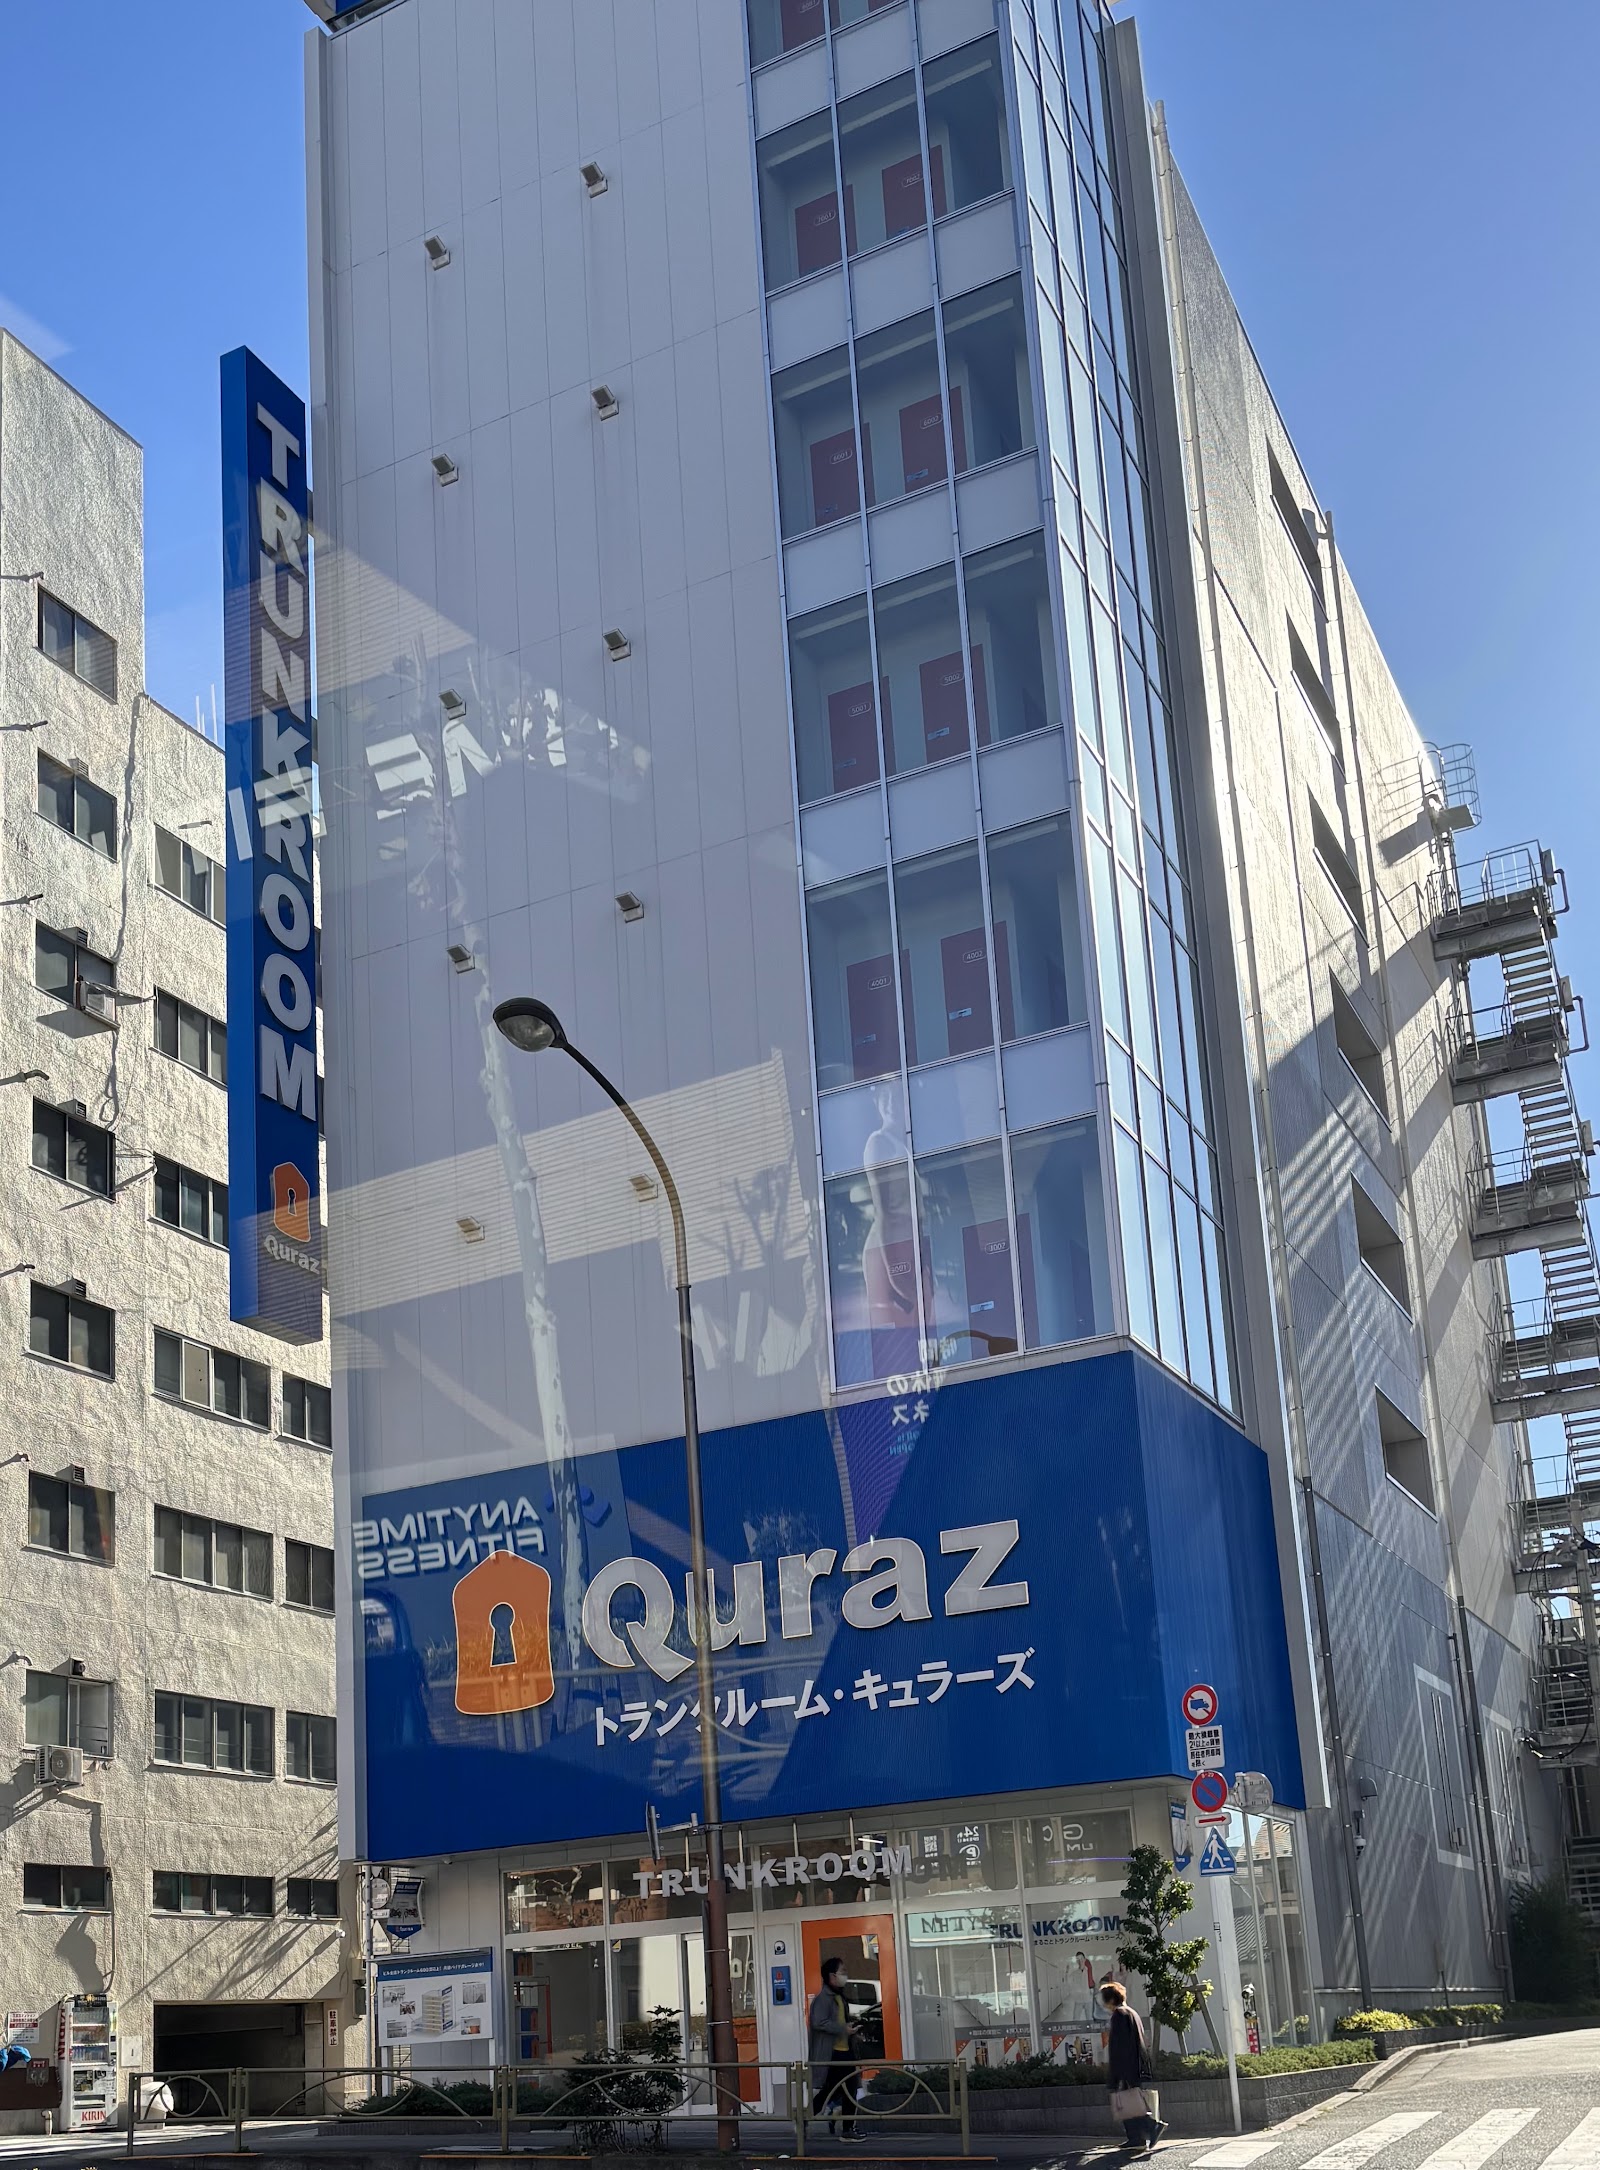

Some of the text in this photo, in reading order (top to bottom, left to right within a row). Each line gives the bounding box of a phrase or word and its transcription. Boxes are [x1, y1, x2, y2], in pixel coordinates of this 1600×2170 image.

[851, 703, 868, 714] 5001
[256, 402, 317, 1122] TRUNKROOM
[966, 950, 984, 961] 4002
[871, 977, 888, 988] 4001
[263, 1234, 321, 1275] Quraz
[581, 1518, 1031, 1683] Quraz
[633, 1845, 912, 1900] TRUNKROOM
[81, 2110, 107, 2122] KIRIN
